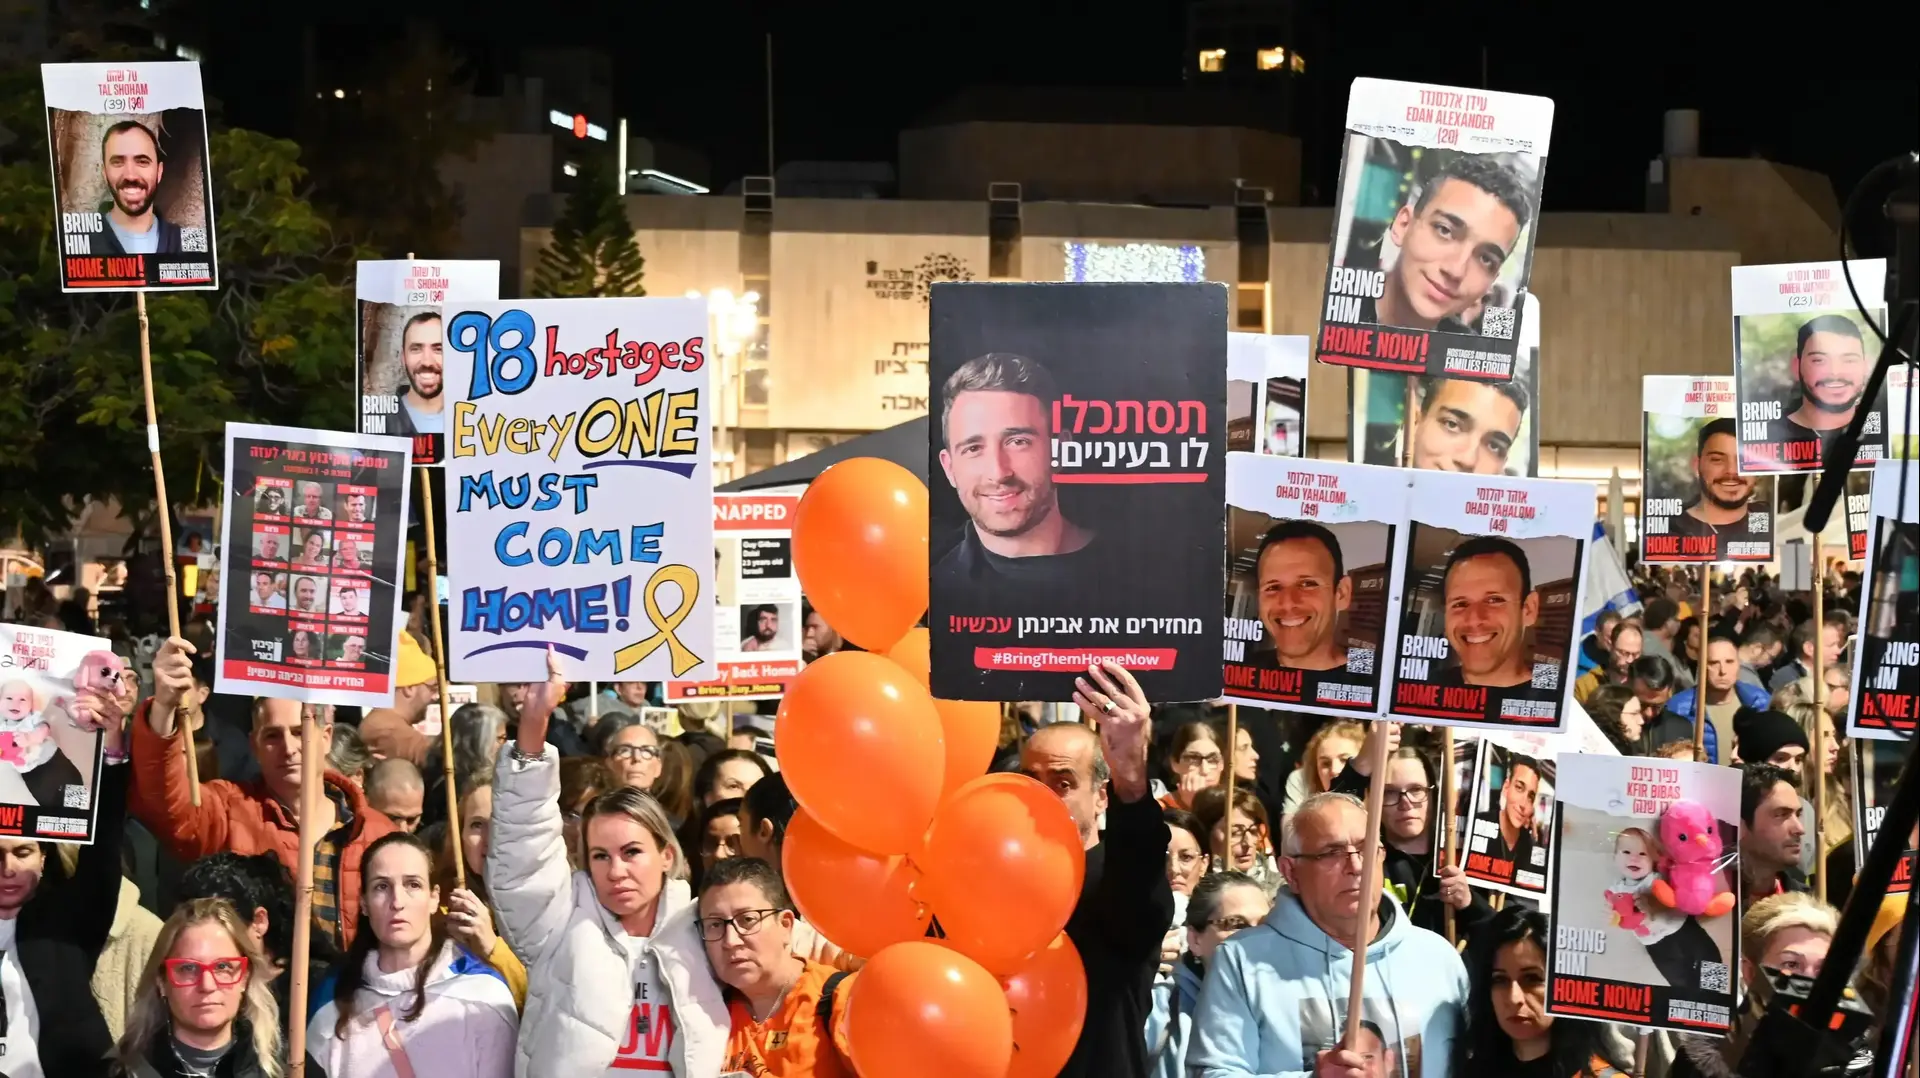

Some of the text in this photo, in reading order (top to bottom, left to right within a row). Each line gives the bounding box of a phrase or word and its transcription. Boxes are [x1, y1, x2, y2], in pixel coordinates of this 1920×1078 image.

[98, 84, 148, 95] TAL SHOHAM
[104, 98, 125, 111] (39)
[1420, 90, 1488, 112] עידן אלכסנדר
[1406, 106, 1495, 130] EDAN ALEXANDER
[1437, 128, 1459, 146] (20)
[63, 212, 103, 233] BRING
[65, 235, 90, 254] HIM
[67, 254, 145, 278] HOME NOW!
[160, 269, 210, 279] FAMILIES FORUM
[418, 279, 448, 289] SHOHAM
[1330, 267, 1385, 297] BRING
[408, 292, 427, 303] (39)
[1789, 296, 1812, 307] (23)
[1326, 295, 1361, 324] HIM
[1322, 325, 1429, 362] HOME NOW!
[447, 309, 704, 400] 98 hostages
[1447, 348, 1511, 362] HOSTAGES AND MISSING
[1445, 357, 1510, 375] FAMILIES FORUM
[362, 395, 399, 414] BRING
[1685, 393, 1704, 402] OMER
[1052, 394, 1206, 434] תסתכלו
[1704, 404, 1718, 414] (22)
[1742, 401, 1782, 421] BRING
[362, 415, 386, 433] HIM
[453, 388, 699, 463] EveryONE
[1743, 421, 1767, 441] HIM
[414, 434, 433, 455] W!
[1050, 437, 1209, 468] לו בעיניים!
[1743, 438, 1822, 462] HOME NOW!
[1862, 451, 1883, 460] FORUM
[1288, 472, 1338, 488] אוהד יהלומי
[457, 470, 598, 515] MUST
[1276, 485, 1346, 504] OHAD YAHALOMI
[1477, 488, 1528, 503] אוהד יהלומי
[714, 504, 787, 521] NAPPED
[1301, 502, 1318, 517] (49)
[1465, 502, 1536, 519] OHAD YAHALOMI
[1646, 499, 1682, 516] BRING
[1848, 494, 1870, 513] BRI
[1489, 518, 1508, 533] (49)
[1646, 517, 1669, 534] HIM
[494, 521, 664, 567] COME
[1646, 534, 1716, 553] HOME NOW!
[1852, 533, 1867, 551] HO
[460, 574, 632, 636] HOME!
[950, 615, 1202, 639] מחזירים את אבינתן עכשיו!
[12, 644, 30, 656] KFIR
[1402, 634, 1448, 659] BRING
[1881, 642, 1919, 666] RING
[992, 652, 1159, 668] #BringThemHomeNow
[1400, 658, 1429, 681] HIM
[732, 664, 759, 678] Back
[762, 665, 797, 677] Home
[1224, 665, 1303, 693] OME NOW!
[1317, 689, 1372, 702] FAMILIES FORUM
[1397, 683, 1487, 711] HOME NOW!
[1631, 767, 1678, 783] כפיר ביבס
[1627, 782, 1680, 799] KFIR BIBAS
[0, 806, 24, 827] W!
[1468, 853, 1514, 878] HOME NOW!
[1557, 925, 1606, 954] BRING
[1555, 951, 1587, 976] HIM
[635, 982, 648, 1000] ME
[1553, 978, 1650, 1013] HOME NOW!
[1669, 1007, 1730, 1024] FAMILIES FORUM
[772, 1032, 788, 1048] 47
